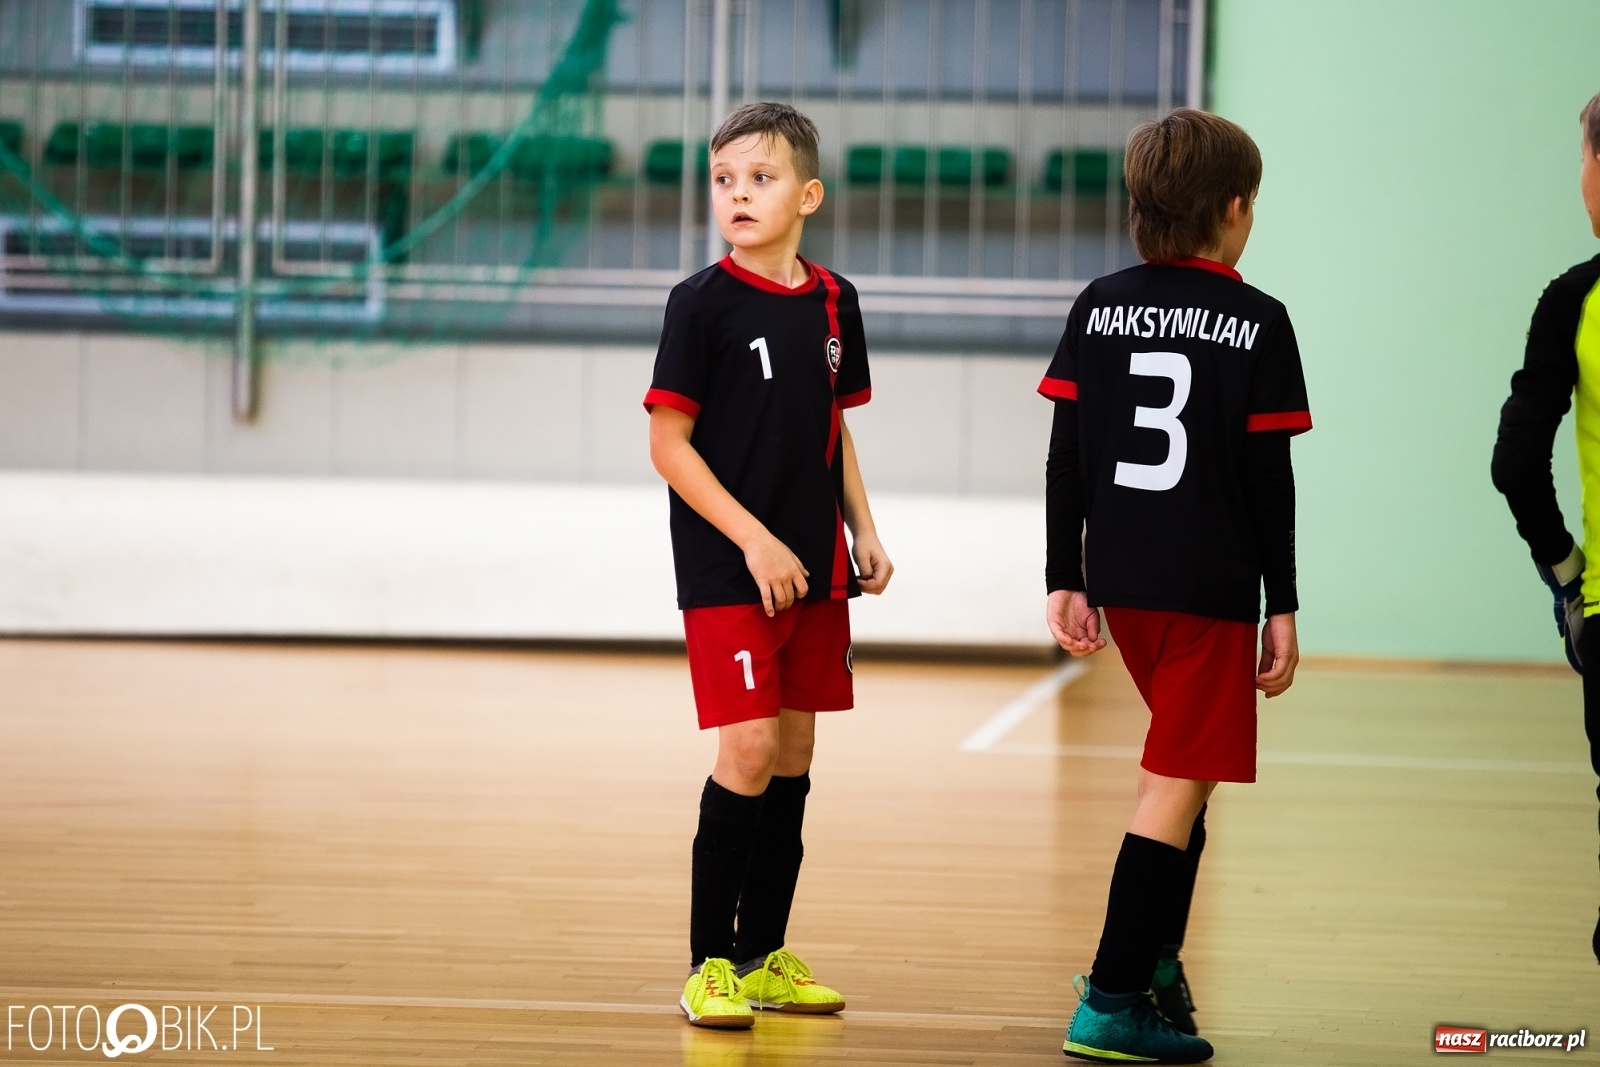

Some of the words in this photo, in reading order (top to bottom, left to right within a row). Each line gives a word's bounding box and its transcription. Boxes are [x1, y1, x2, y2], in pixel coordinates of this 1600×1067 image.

[1086, 305, 1260, 350] MAKSYMILIAN
[749, 337, 773, 380] 1
[1113, 351, 1192, 491] 3
[734, 650, 755, 690] 1
